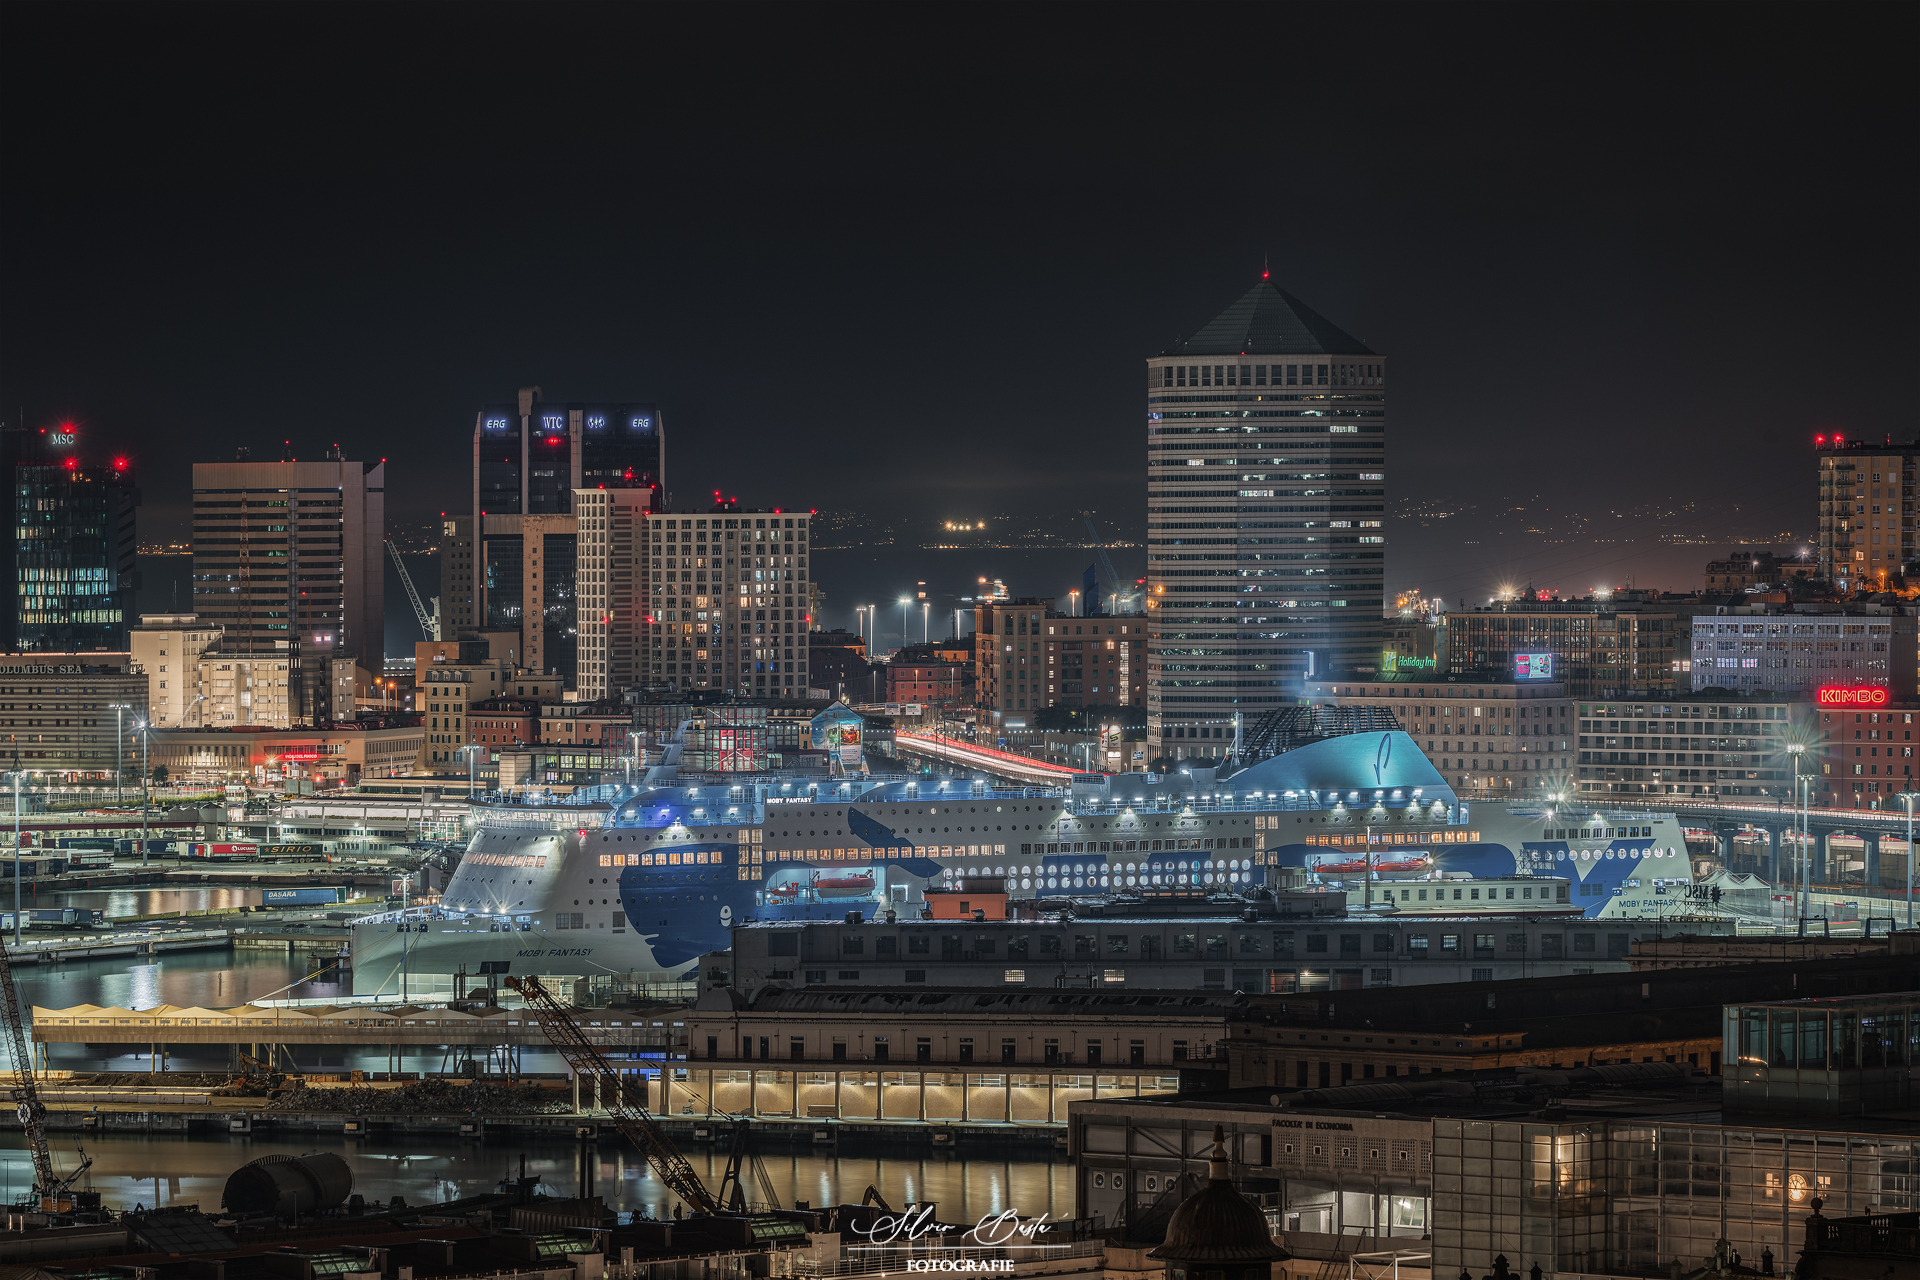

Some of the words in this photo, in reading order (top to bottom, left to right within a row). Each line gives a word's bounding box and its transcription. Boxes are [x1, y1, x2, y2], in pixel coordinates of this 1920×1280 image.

[486, 419, 506, 429] ERG
[543, 416, 562, 429] WTC
[632, 418, 649, 428] ERG
[52, 433, 74, 445] MSC
[1398, 655, 1425, 669] Holiday
[1425, 655, 1437, 667] Inn
[59, 665, 83, 674] SEA
[120, 663, 146, 674] HOTEL
[1821, 689, 1885, 703] KIMBO
[1618, 900, 1641, 908] MOBY
[1643, 899, 1678, 907] FANTASY
[516, 949, 547, 958] MOBY
[548, 948, 593, 957] FANTASY
[1305, 1121, 1313, 1129] DI
[1315, 1121, 1354, 1131] ECONOMIA
